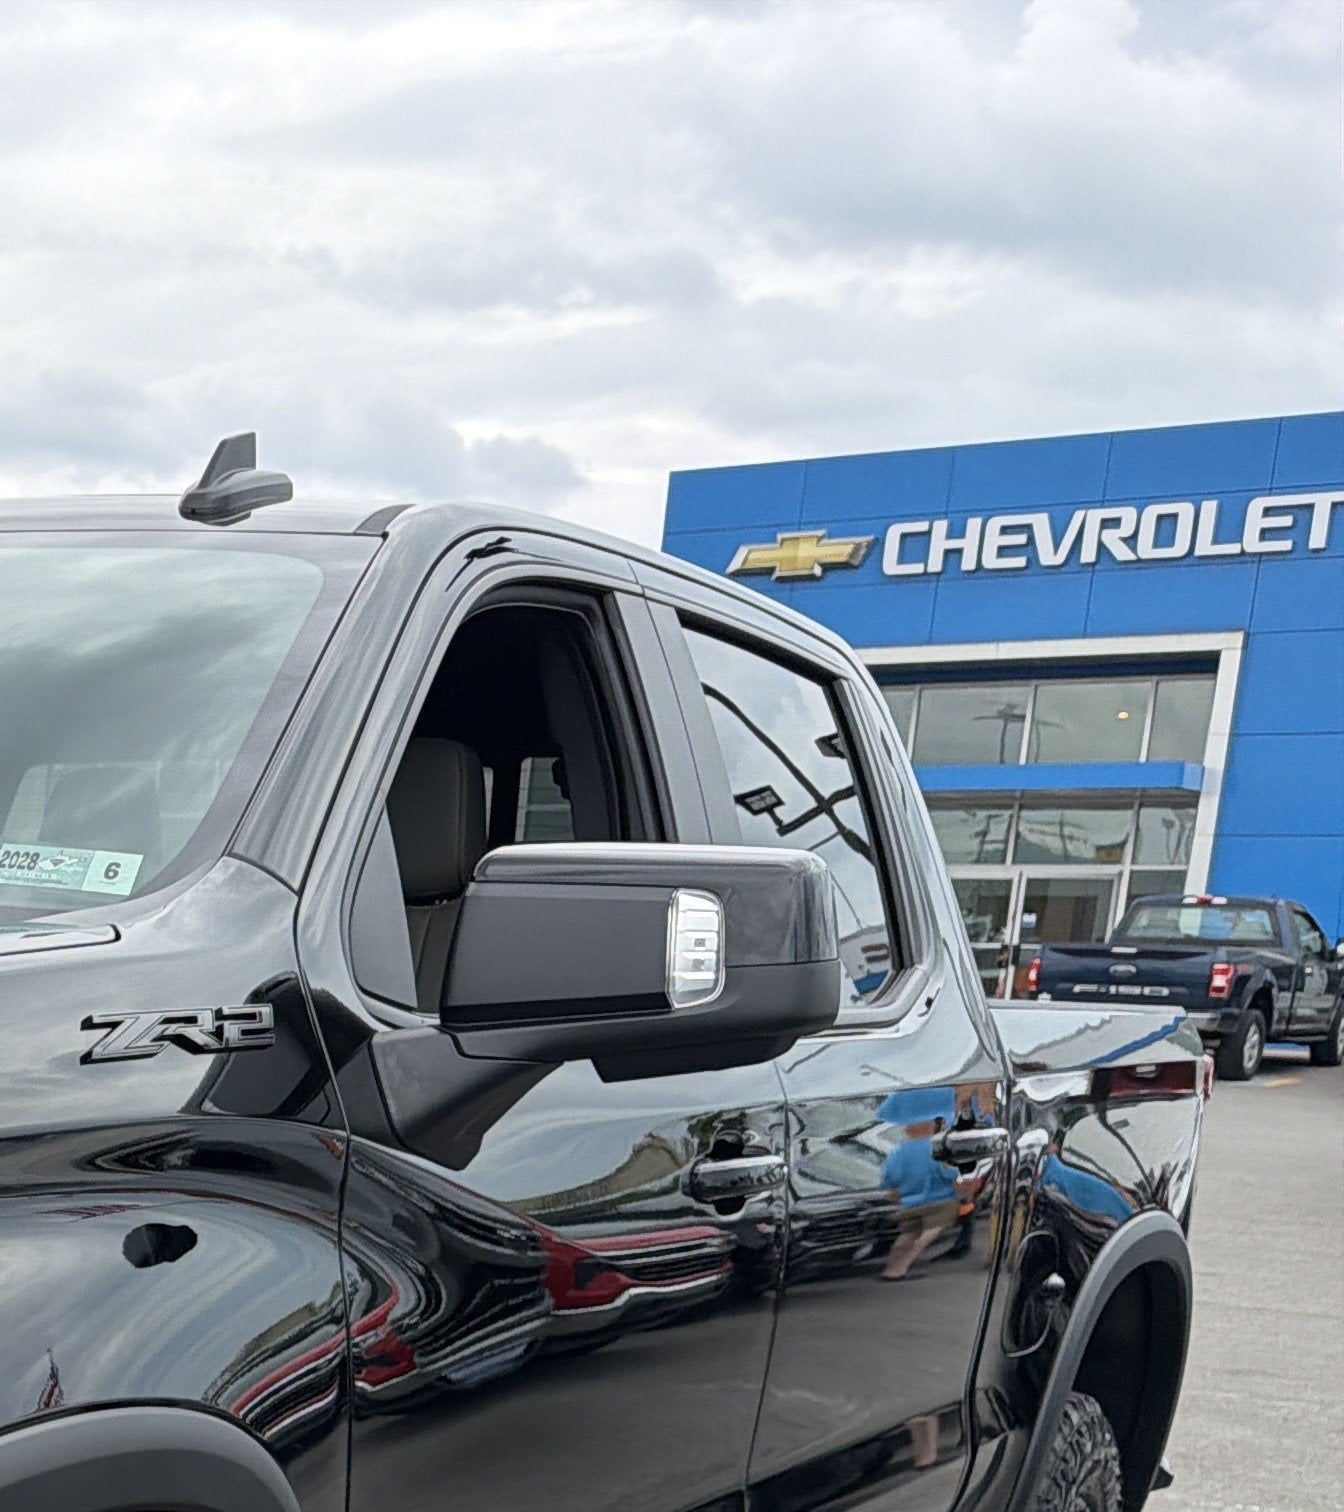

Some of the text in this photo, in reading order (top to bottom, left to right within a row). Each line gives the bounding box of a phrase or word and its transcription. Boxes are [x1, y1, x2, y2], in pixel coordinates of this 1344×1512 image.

[882, 491, 1344, 576] CHEVROLET
[104, 861, 122, 880] 6
[80, 1003, 276, 1066] ZR2
